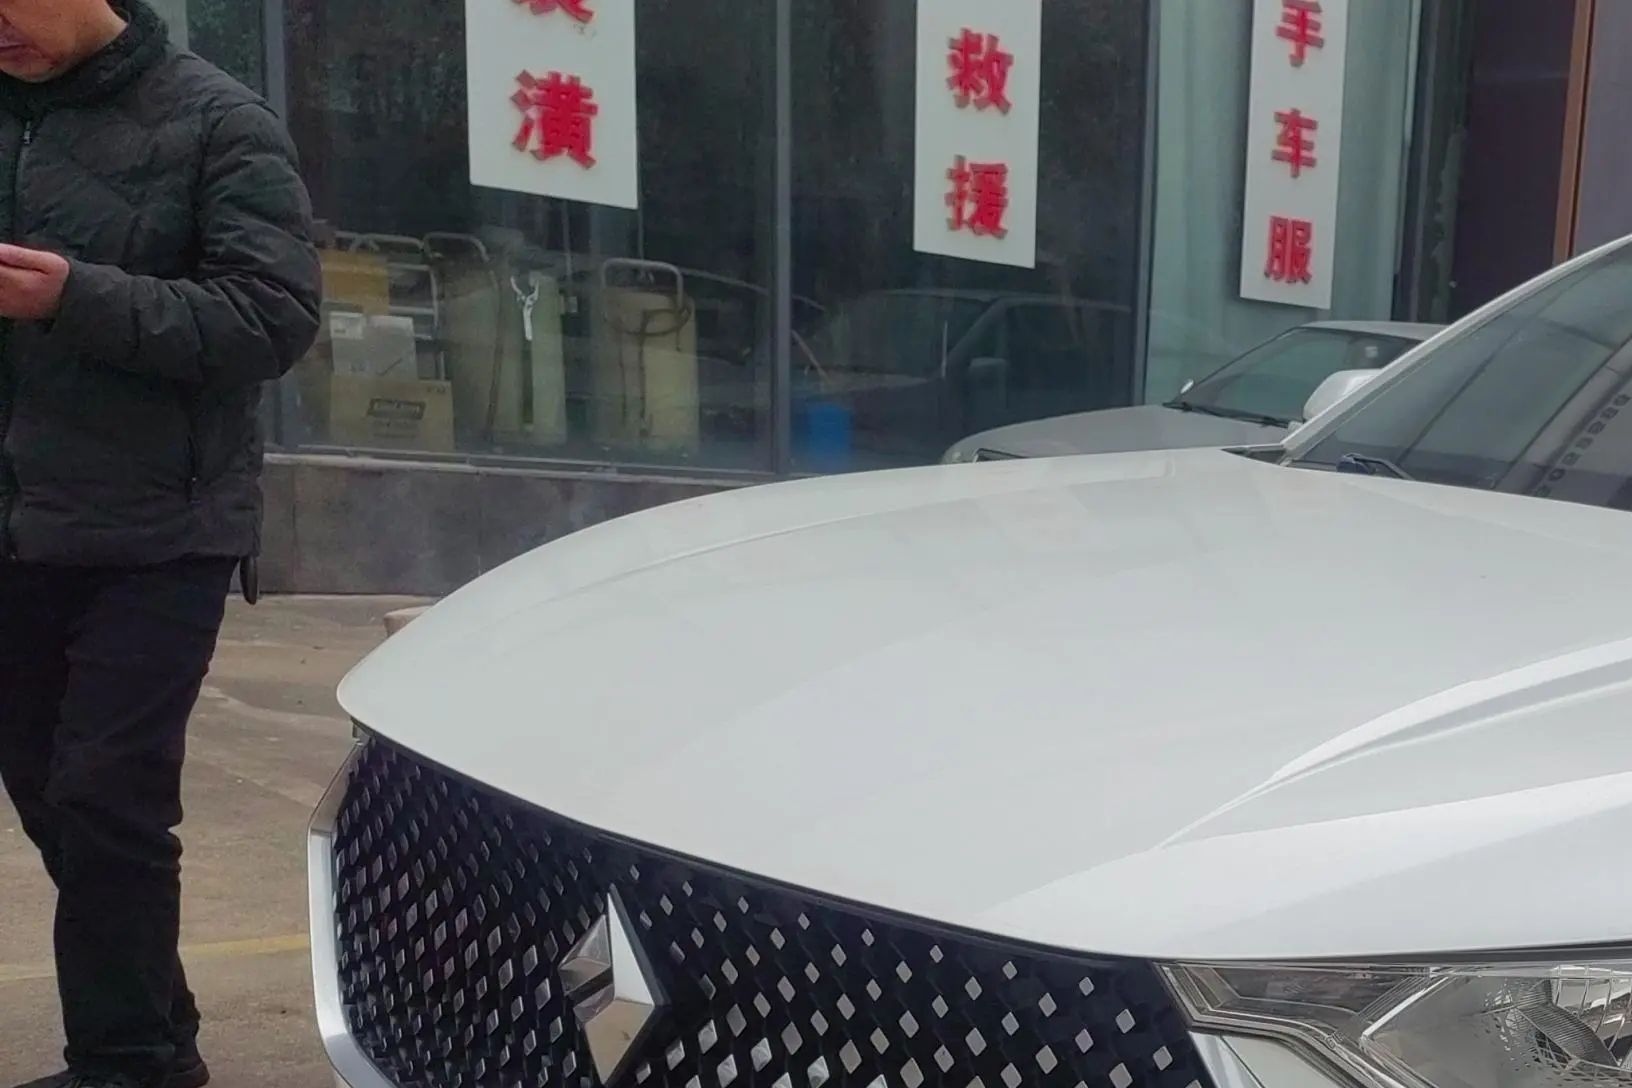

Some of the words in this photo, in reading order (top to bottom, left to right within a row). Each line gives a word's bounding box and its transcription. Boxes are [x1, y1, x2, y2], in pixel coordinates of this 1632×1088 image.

[944, 27, 1014, 240] 救援
[1263, 0, 1324, 284] 手车服
